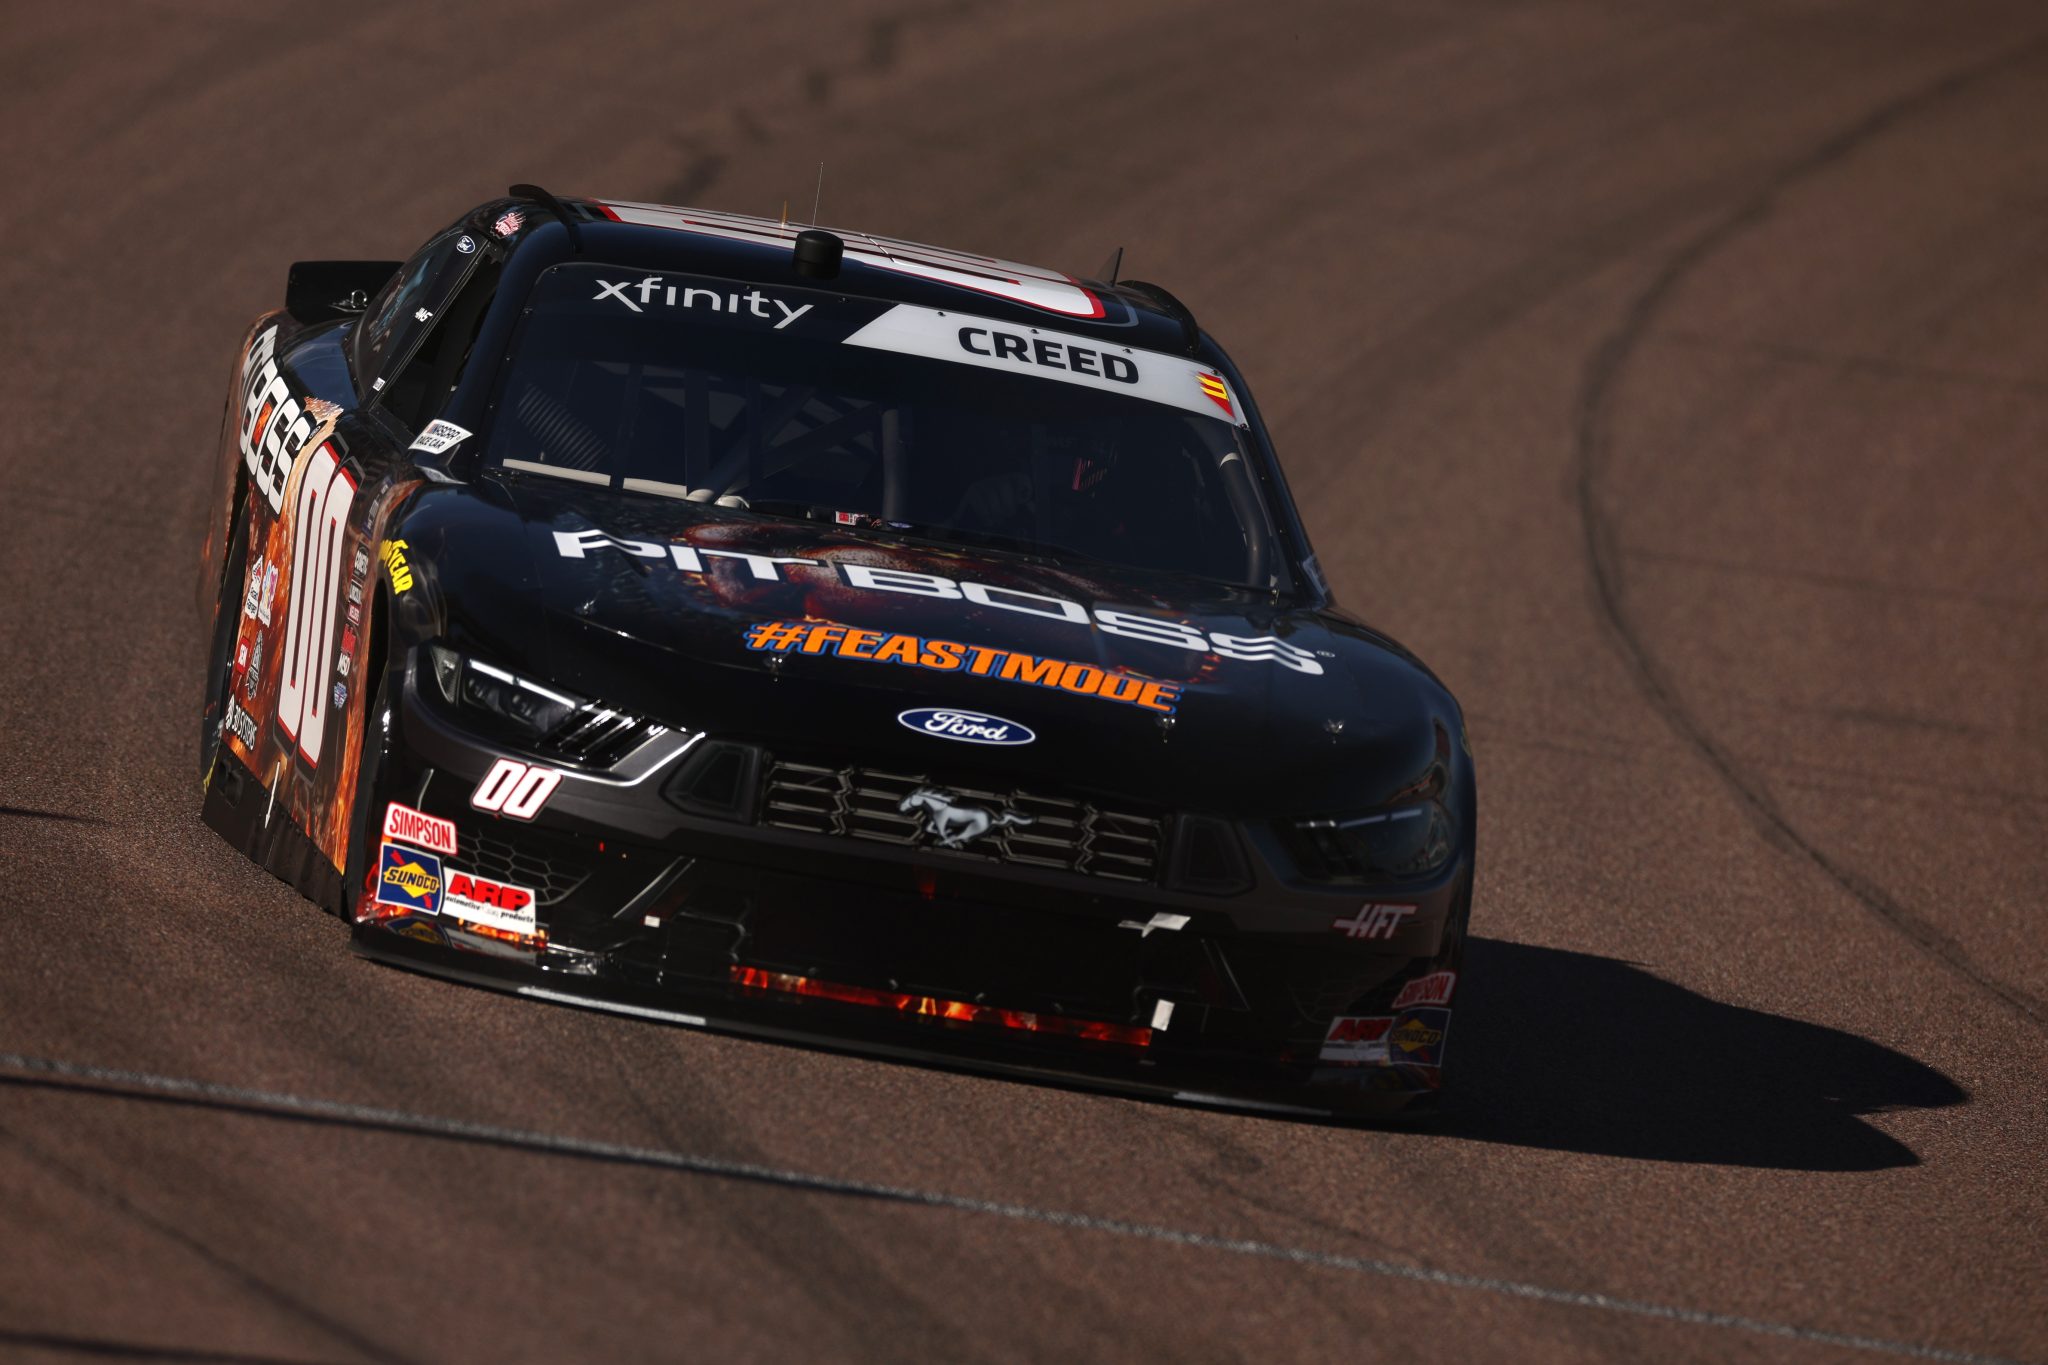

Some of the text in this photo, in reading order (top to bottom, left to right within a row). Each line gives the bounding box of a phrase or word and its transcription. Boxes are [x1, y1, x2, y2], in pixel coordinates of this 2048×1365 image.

[592, 276, 815, 329] xfinity
[957, 326, 1140, 386] CREED
[277, 440, 359, 769] 00
[552, 529, 1325, 676] PIT BOSS
[746, 621, 1184, 714] #FEASTMODE
[922, 709, 1010, 743] Ford
[471, 757, 564, 821] 00
[389, 807, 452, 850] SIMPSON
[385, 868, 438, 892] SUNOCO
[447, 873, 532, 911] ARP
[500, 911, 534, 923] products
[1392, 1028, 1441, 1045] SUNOCO
